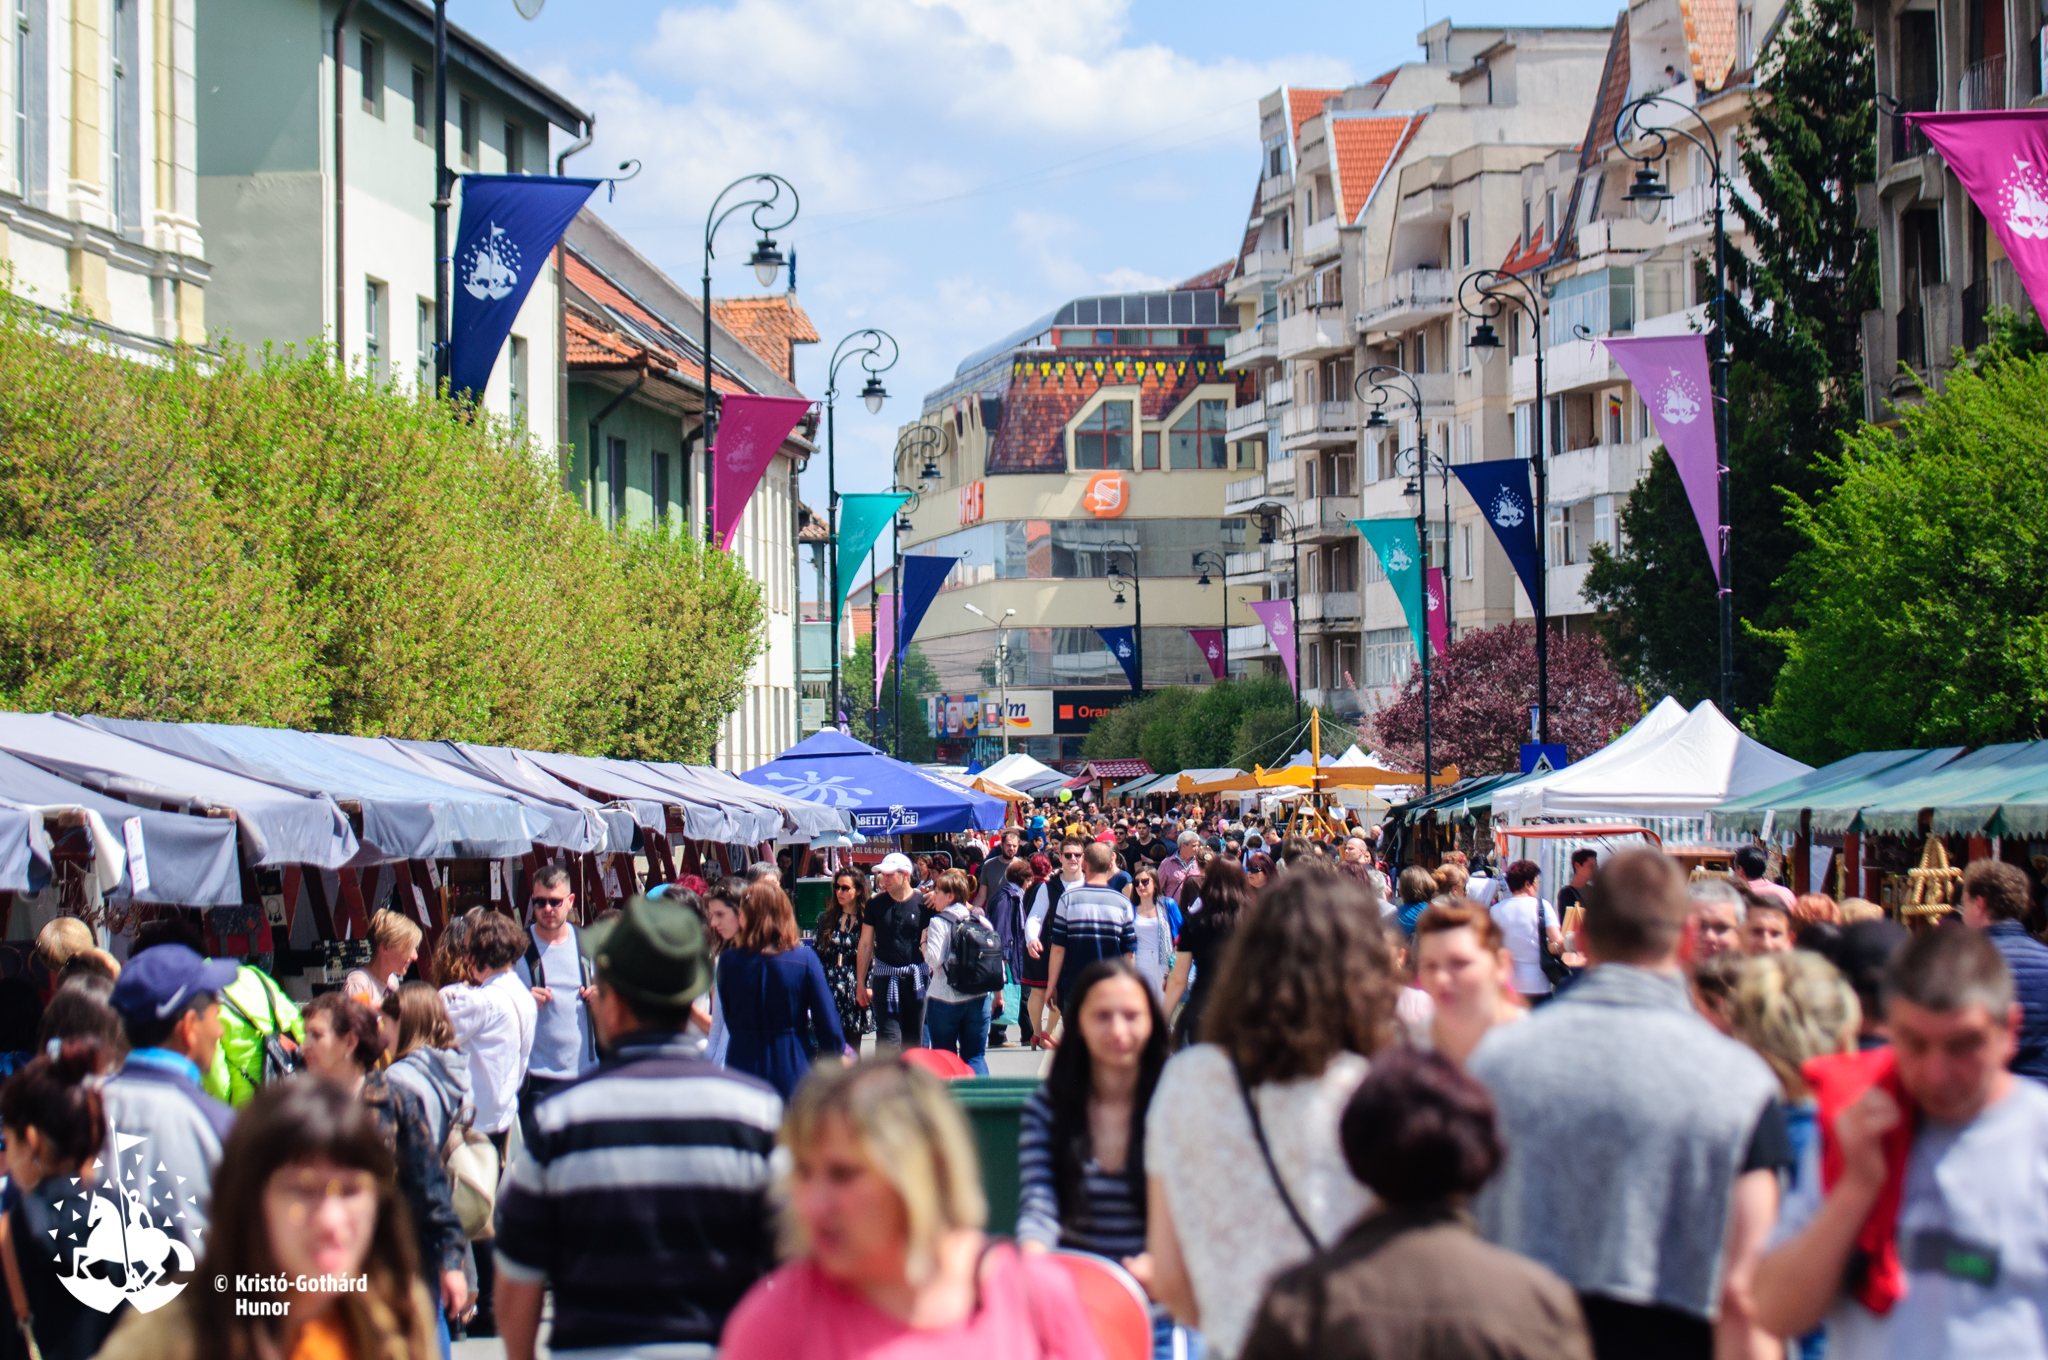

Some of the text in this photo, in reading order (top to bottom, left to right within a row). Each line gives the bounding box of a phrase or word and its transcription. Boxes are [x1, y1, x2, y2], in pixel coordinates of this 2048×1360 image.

[1078, 705, 1122, 718] Oran
[860, 815, 916, 825] BETTY ICE
